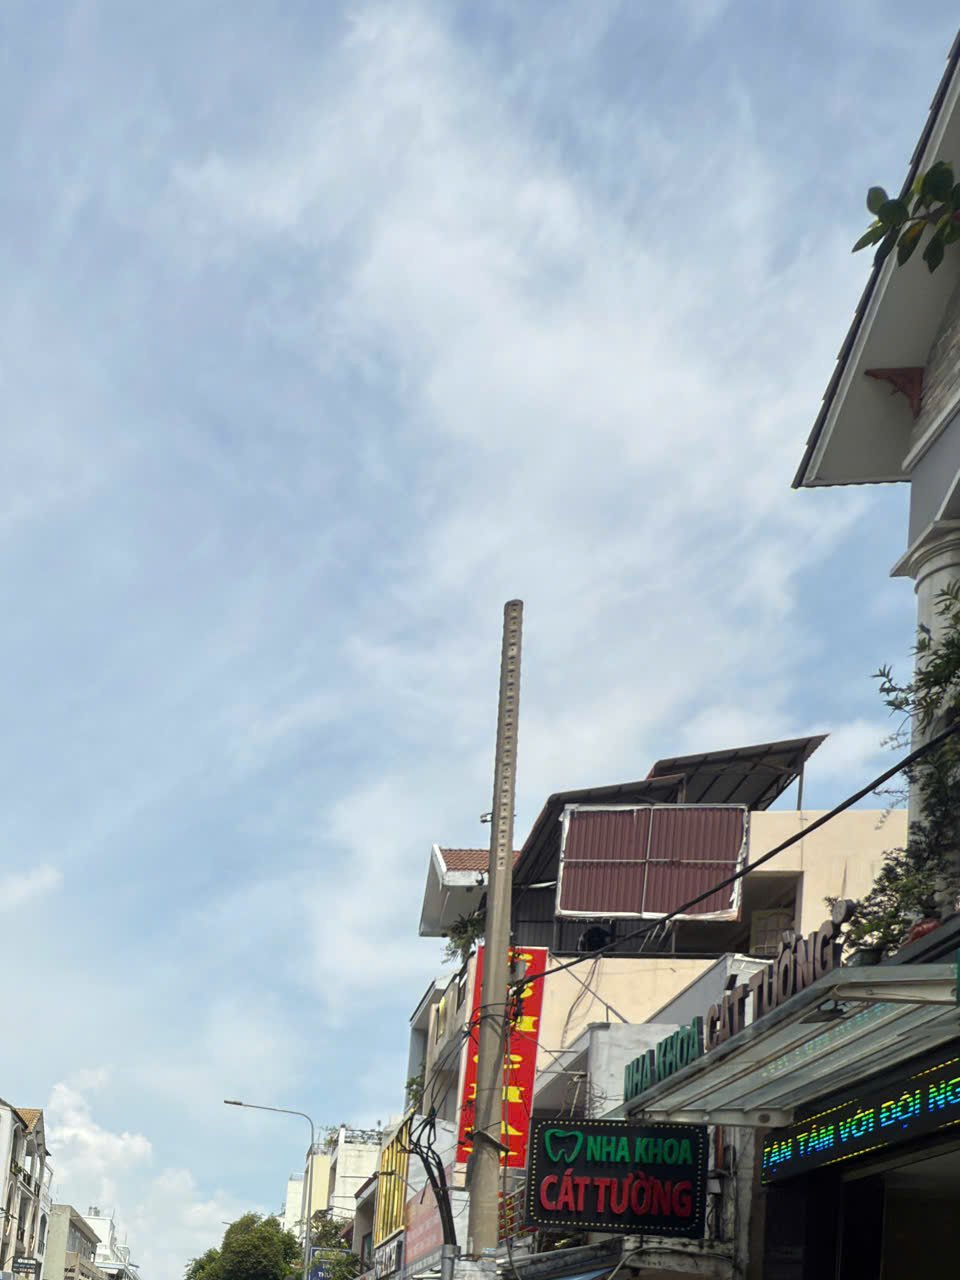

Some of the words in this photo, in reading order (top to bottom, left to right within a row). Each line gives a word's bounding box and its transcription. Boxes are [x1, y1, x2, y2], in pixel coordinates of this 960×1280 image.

[624, 1050, 655, 1102] NHA
[587, 1136, 630, 1163] NHA
[635, 1137, 693, 1165] KHOA
[541, 1168, 589, 1212] CÁT
[594, 1170, 693, 1217] TƯỜNG
